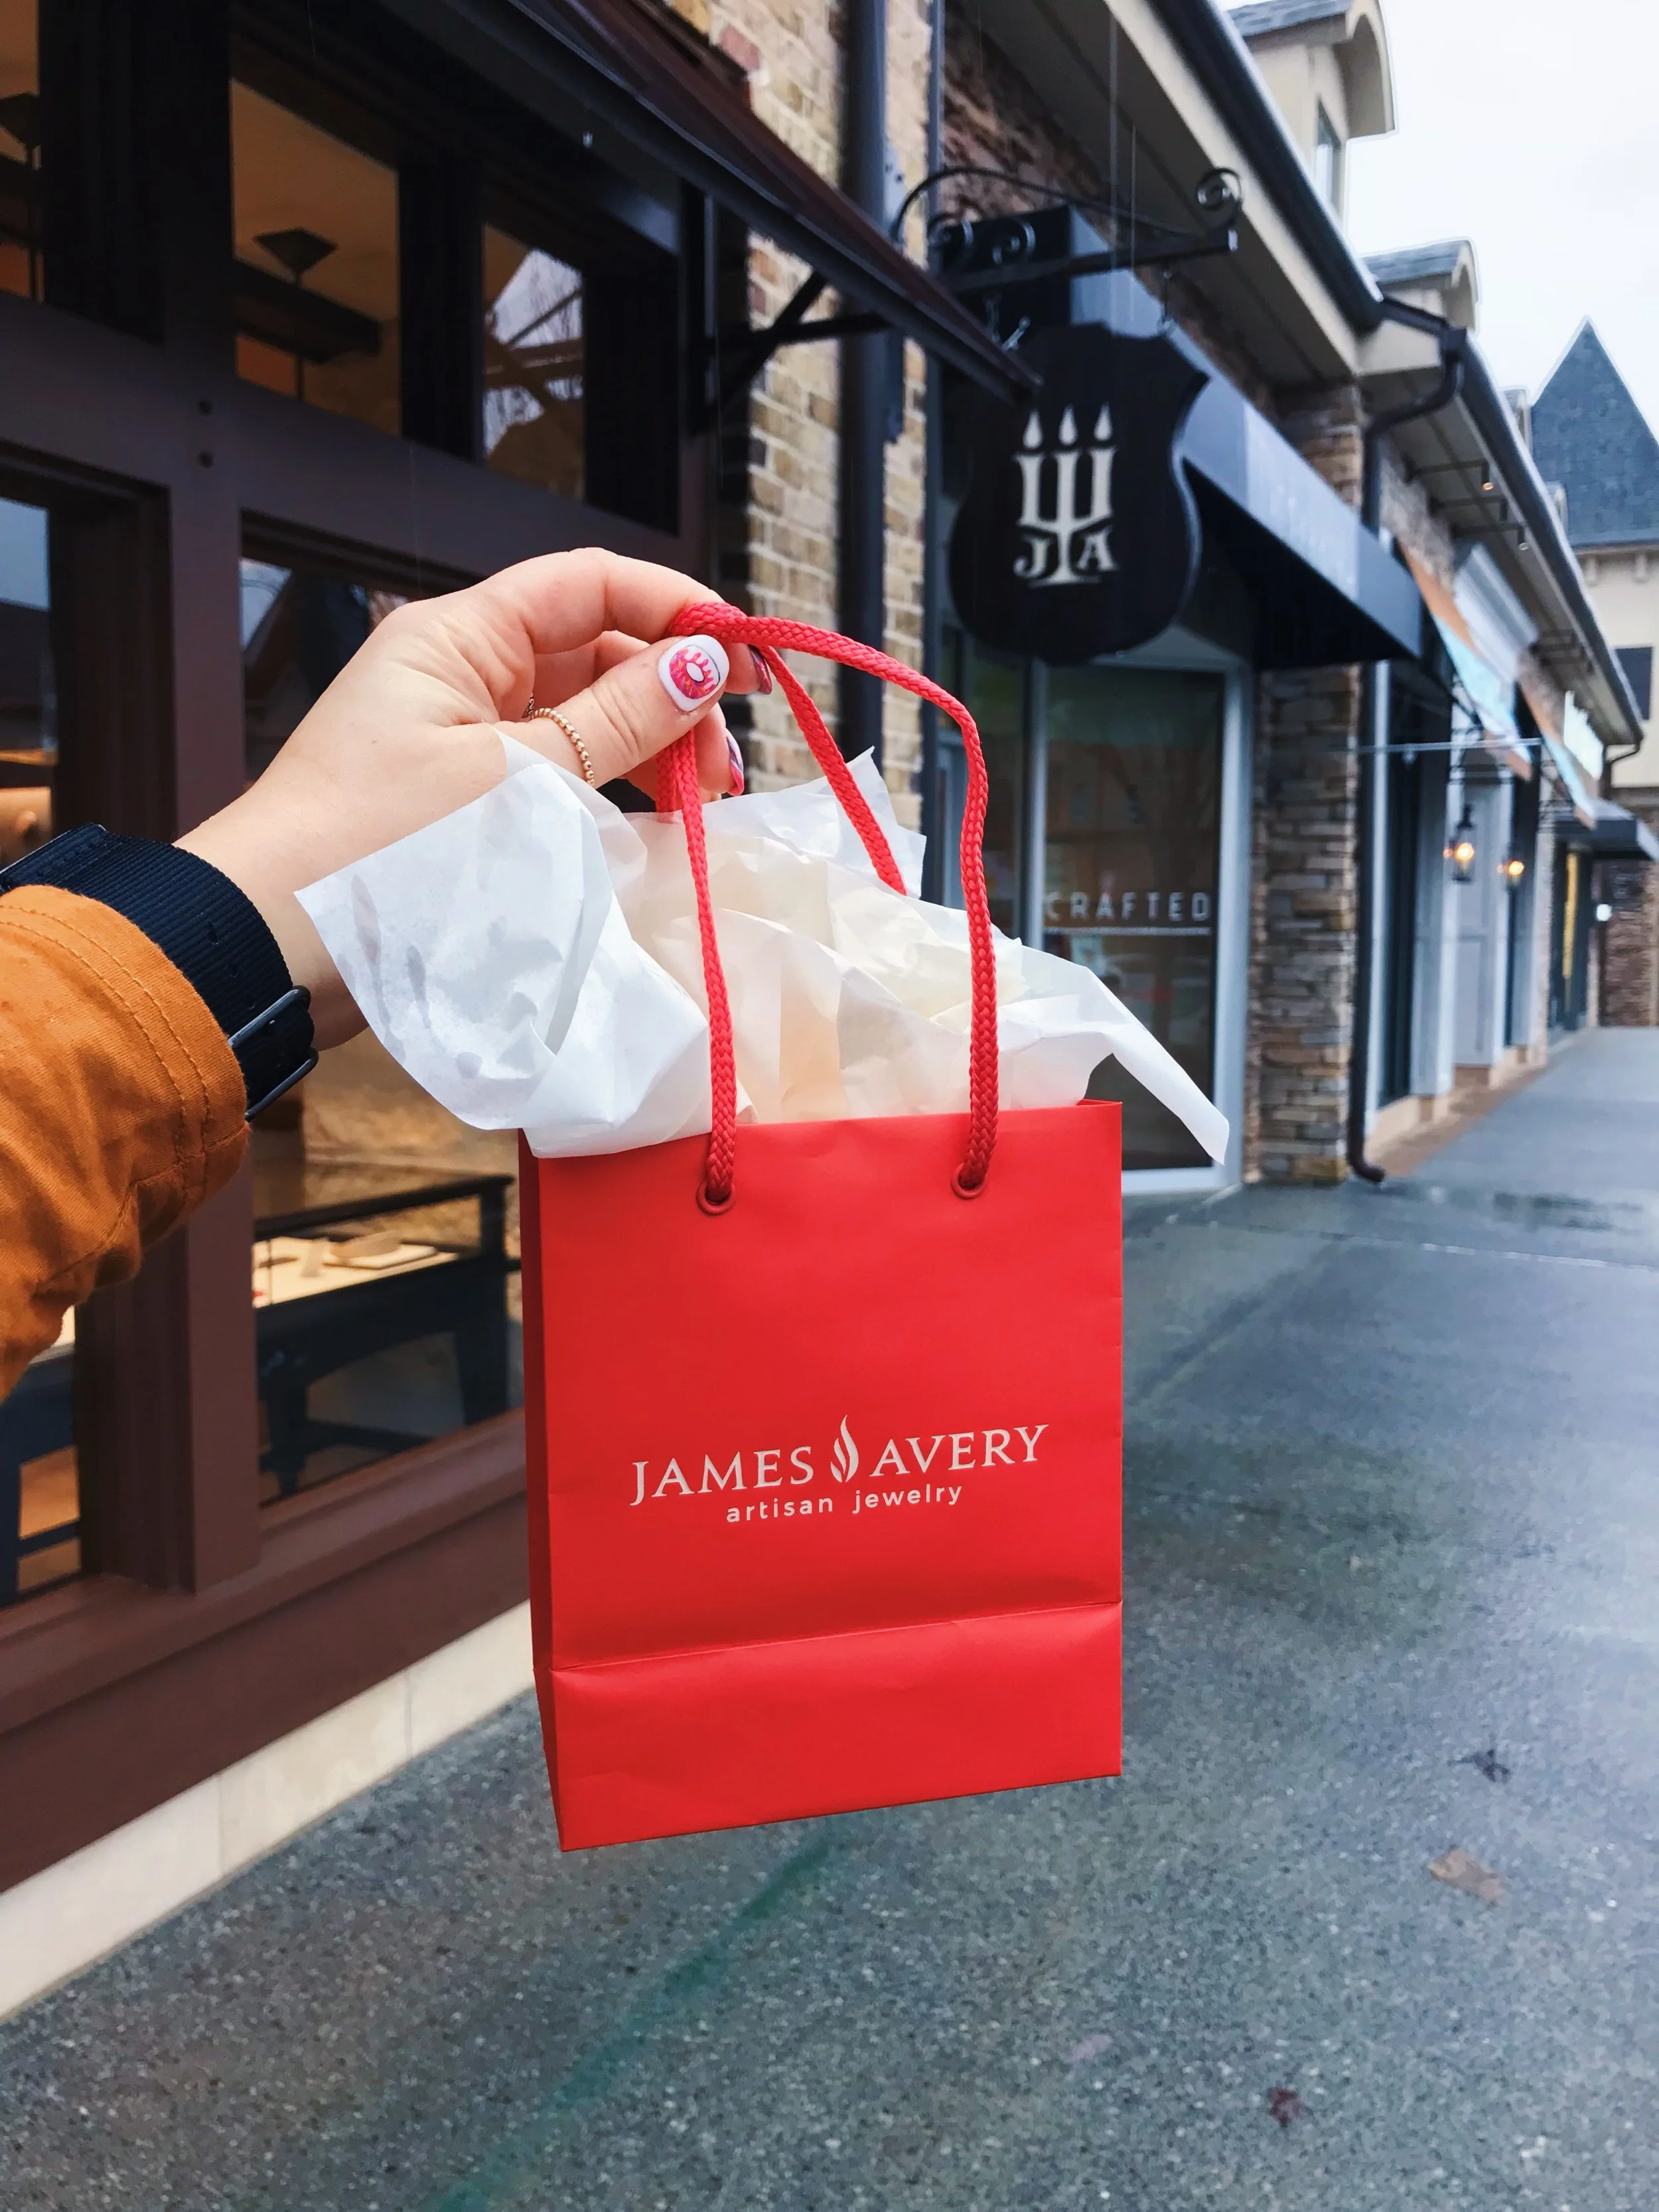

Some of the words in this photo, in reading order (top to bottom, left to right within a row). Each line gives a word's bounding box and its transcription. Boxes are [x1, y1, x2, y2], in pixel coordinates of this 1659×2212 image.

[1045, 891, 1211, 921] CRAFTED
[629, 1446, 814, 1506] JAMES
[869, 1424, 1049, 1477] AVERY
[726, 1497, 833, 1522] artisan
[852, 1483, 962, 1514] jewelry
